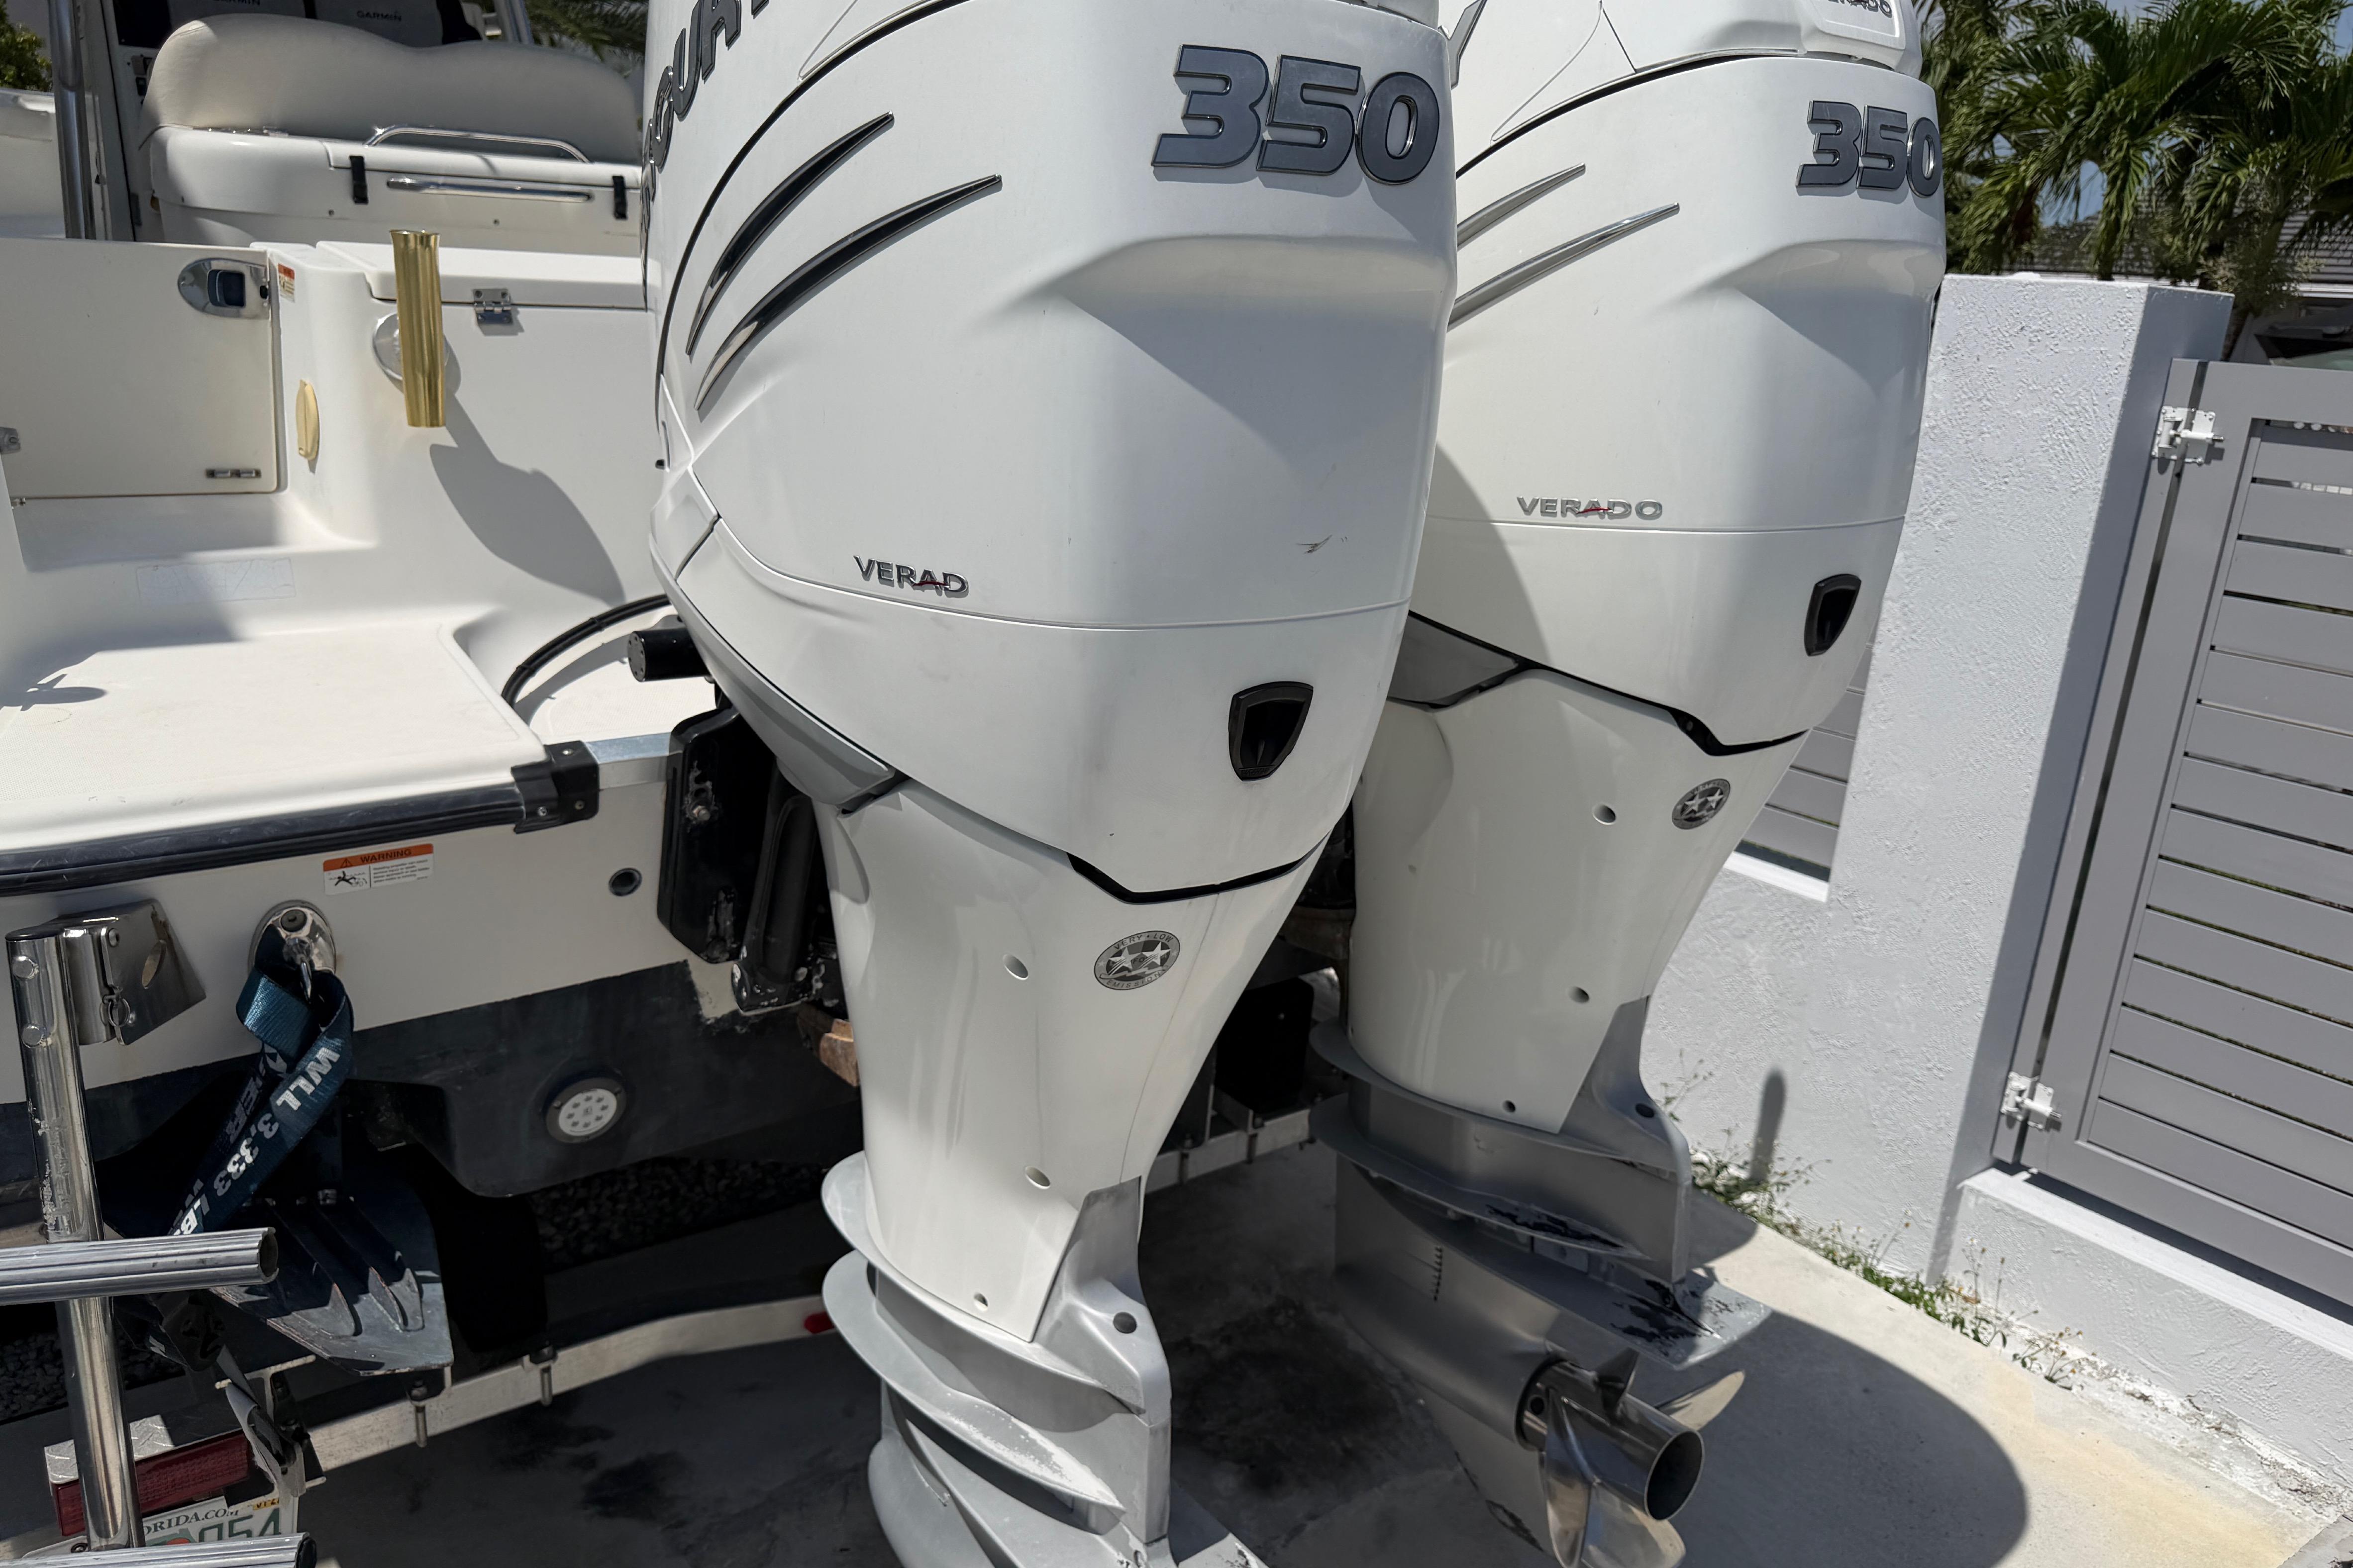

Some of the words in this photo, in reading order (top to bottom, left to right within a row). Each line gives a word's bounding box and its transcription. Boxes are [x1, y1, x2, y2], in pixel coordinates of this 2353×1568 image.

[1151, 44, 1439, 186] 350
[1795, 100, 1942, 198] 350
[1517, 496, 1662, 519] VERADO
[853, 555, 969, 594] VERAD
[360, 848, 412, 864] WARNING
[1114, 935, 1142, 950] VERY
[1153, 933, 1173, 943] LOW
[1106, 972, 1161, 988] EMISSION
[276, 1046, 341, 1111] WLL
[213, 1113, 279, 1196] 3,333
